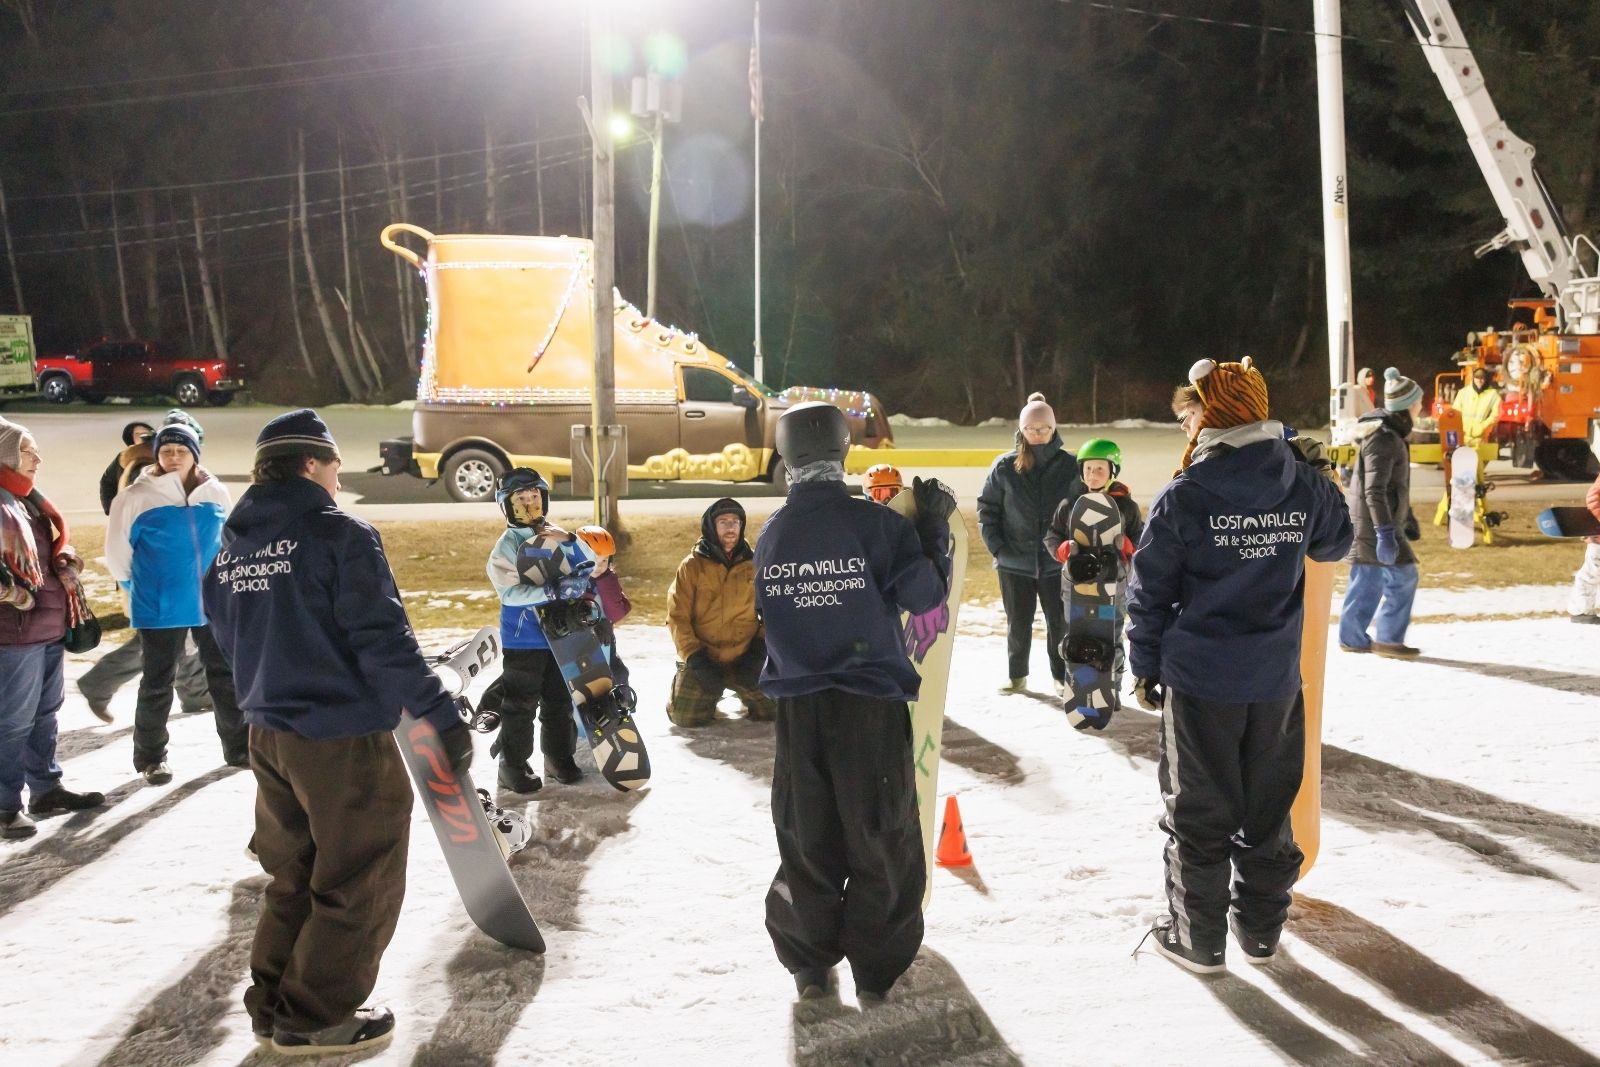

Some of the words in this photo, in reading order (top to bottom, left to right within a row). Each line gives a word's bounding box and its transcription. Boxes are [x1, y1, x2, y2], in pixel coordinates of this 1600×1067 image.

[1209, 515, 1242, 529] LOST
[1258, 512, 1307, 527] VALLEY
[1214, 535, 1229, 546] SKI
[1231, 535, 1239, 546] &
[1241, 531, 1304, 546] SNOWBOARD
[1239, 545, 1277, 560] SCHOOL
[763, 563, 797, 579] LOST
[815, 558, 866, 575] VALLEY
[232, 578, 270, 594] SCHOOL
[765, 584, 781, 597] SKI
[784, 584, 795, 595] &
[797, 577, 866, 594] SNOWBOARD
[793, 594, 842, 608] SCHOOL
